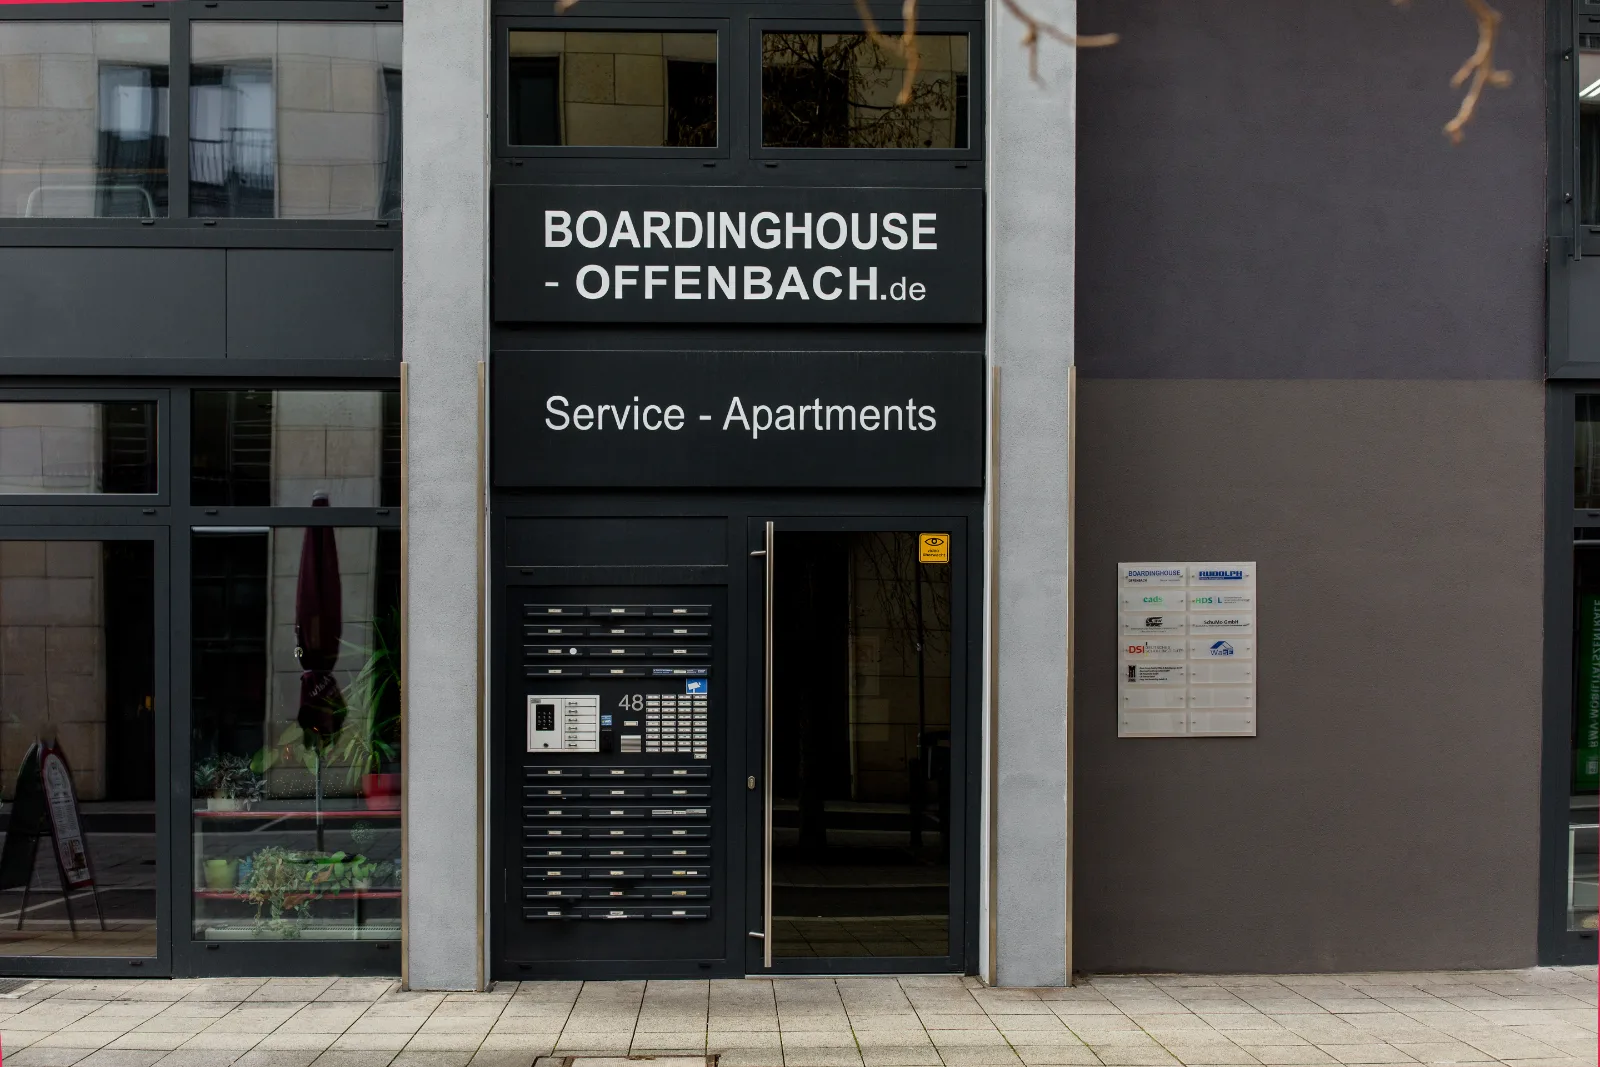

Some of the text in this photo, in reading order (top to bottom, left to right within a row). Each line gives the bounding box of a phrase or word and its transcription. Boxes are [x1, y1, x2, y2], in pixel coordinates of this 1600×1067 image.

[544, 210, 938, 250] BOARDINGHOUSE
[575, 264, 927, 301] OFFENBACH.de
[545, 395, 685, 431] Service
[722, 396, 937, 439] Apartments
[1128, 645, 1145, 654] DSI
[618, 694, 644, 711] 48
